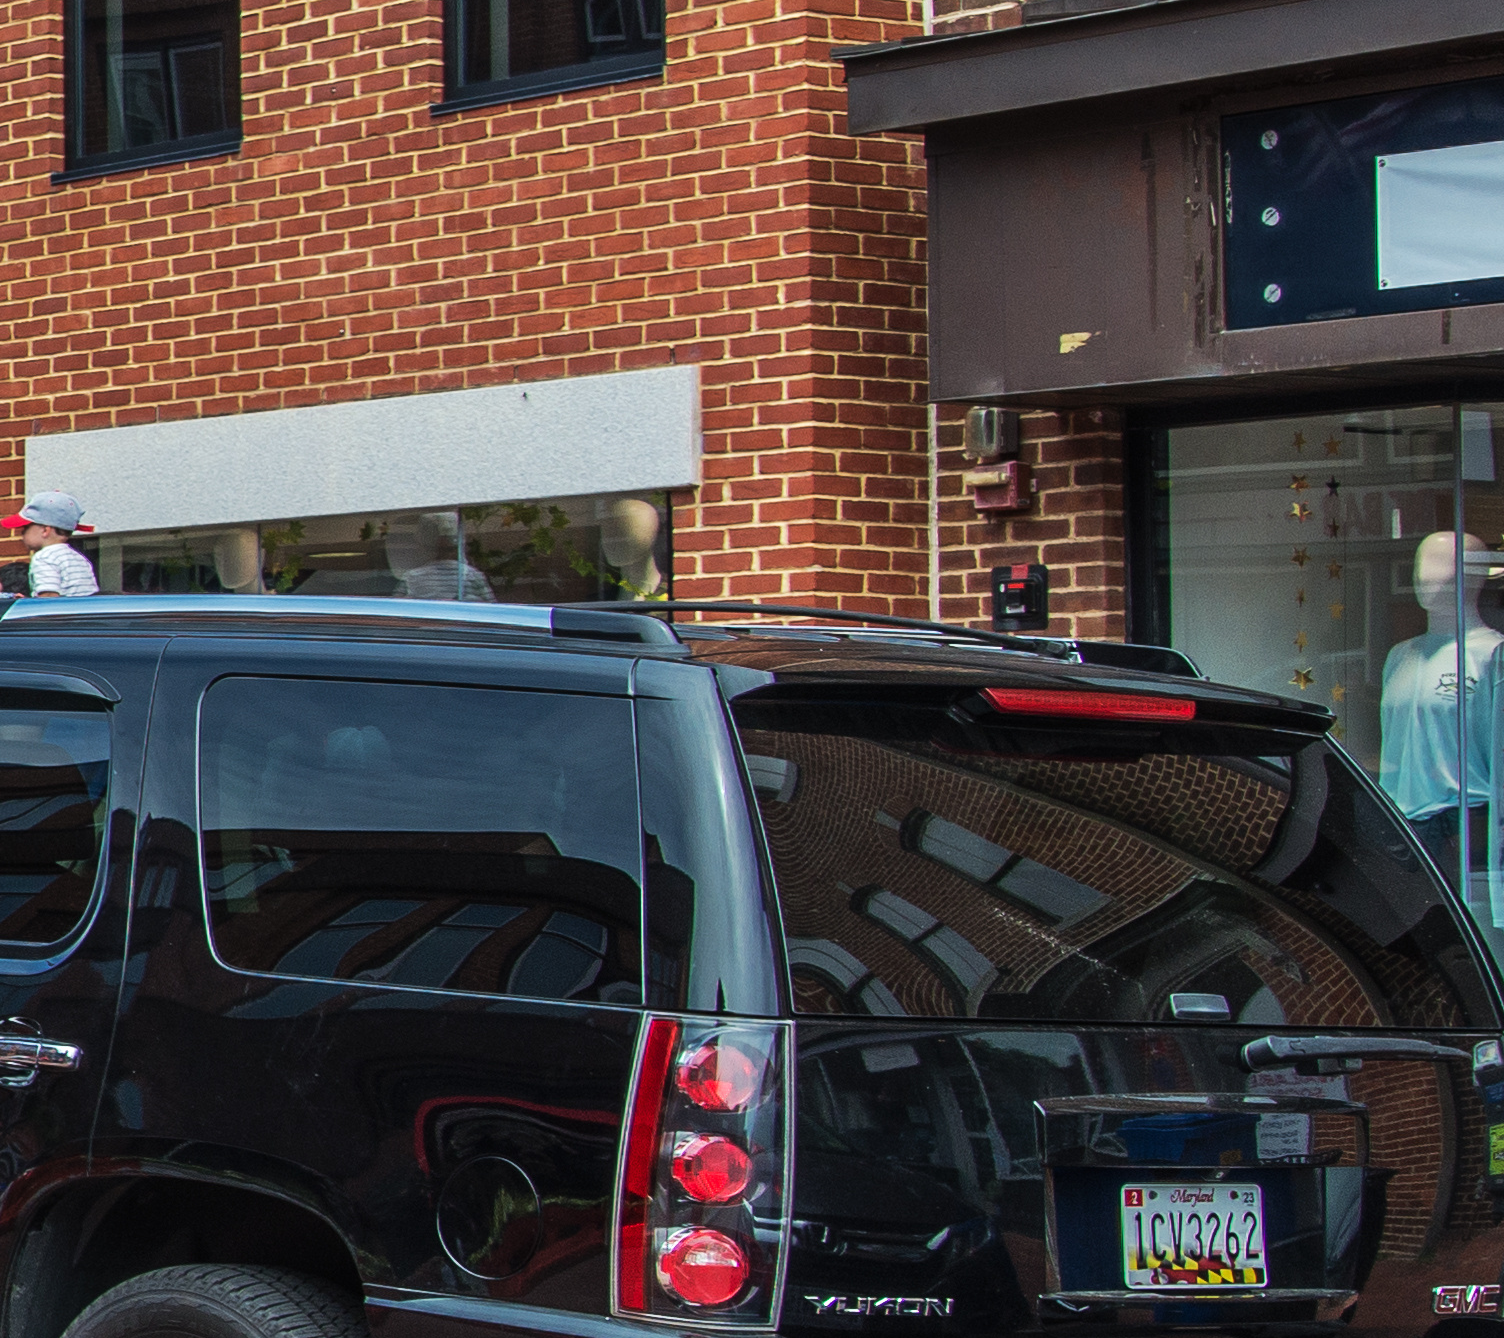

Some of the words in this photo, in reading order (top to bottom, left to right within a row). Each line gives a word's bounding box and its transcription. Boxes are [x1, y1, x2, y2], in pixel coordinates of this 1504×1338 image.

[1170, 1188, 1215, 1207] Maryland
[1243, 1192, 1255, 1203] 23
[1134, 1211, 1260, 1262] 1CV3262
[804, 1295, 955, 1317] YUKON
[1432, 1284, 1501, 1315] GMC
